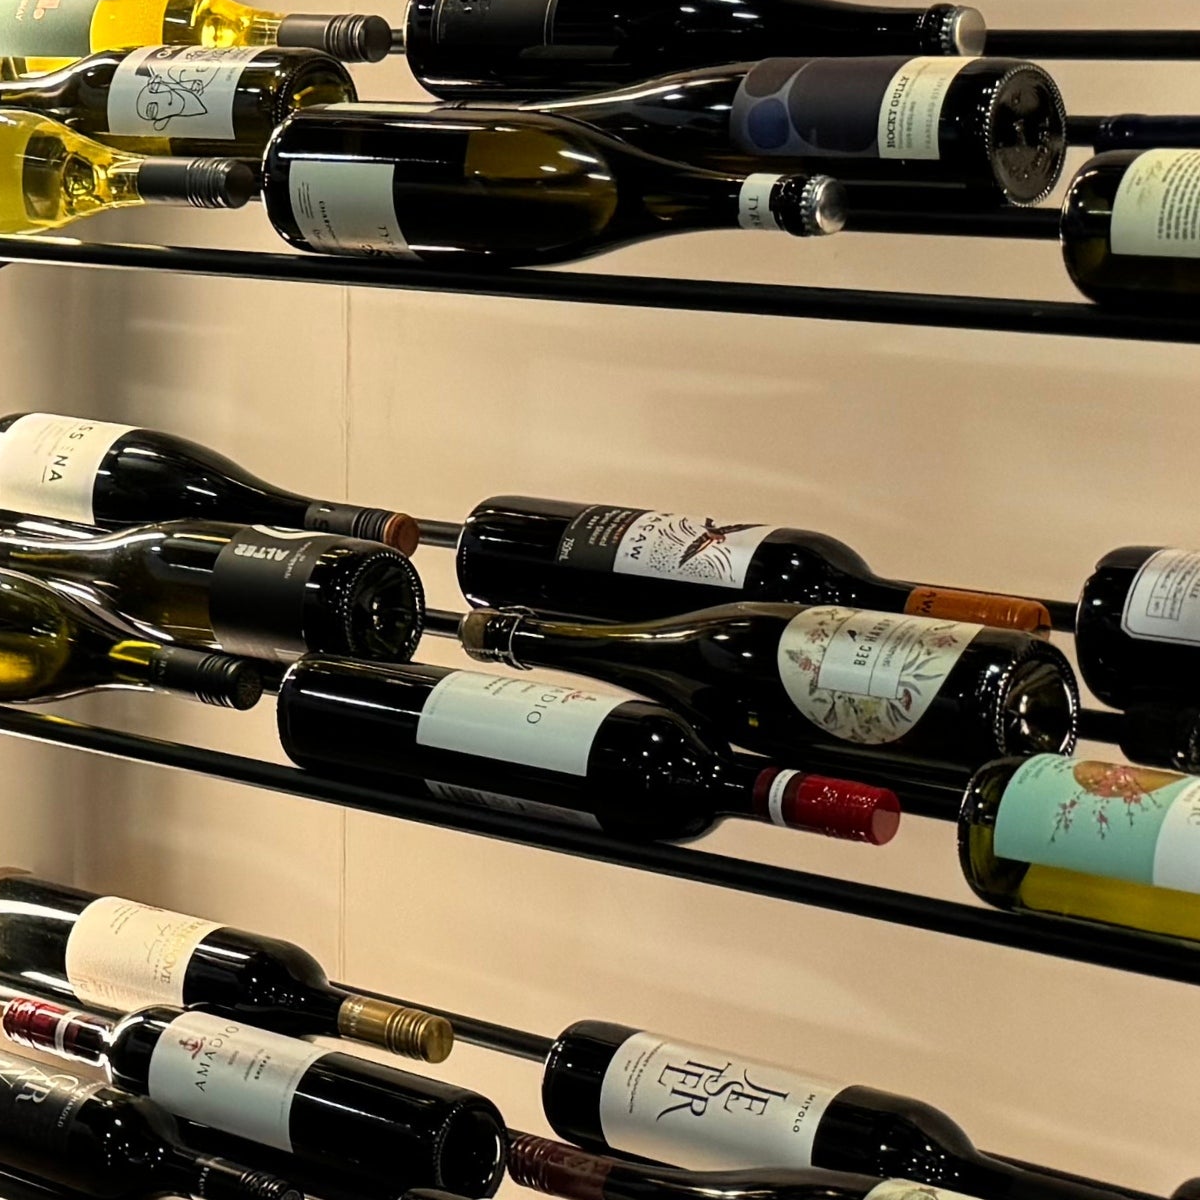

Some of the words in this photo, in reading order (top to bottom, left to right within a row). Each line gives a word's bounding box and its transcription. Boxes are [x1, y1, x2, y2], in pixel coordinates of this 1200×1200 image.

[890, 76, 910, 108] GULLY
[853, 644, 873, 667] BEC
[194, 1026, 240, 1093] AMADIO
[792, 1093, 817, 1134] MITOLO
